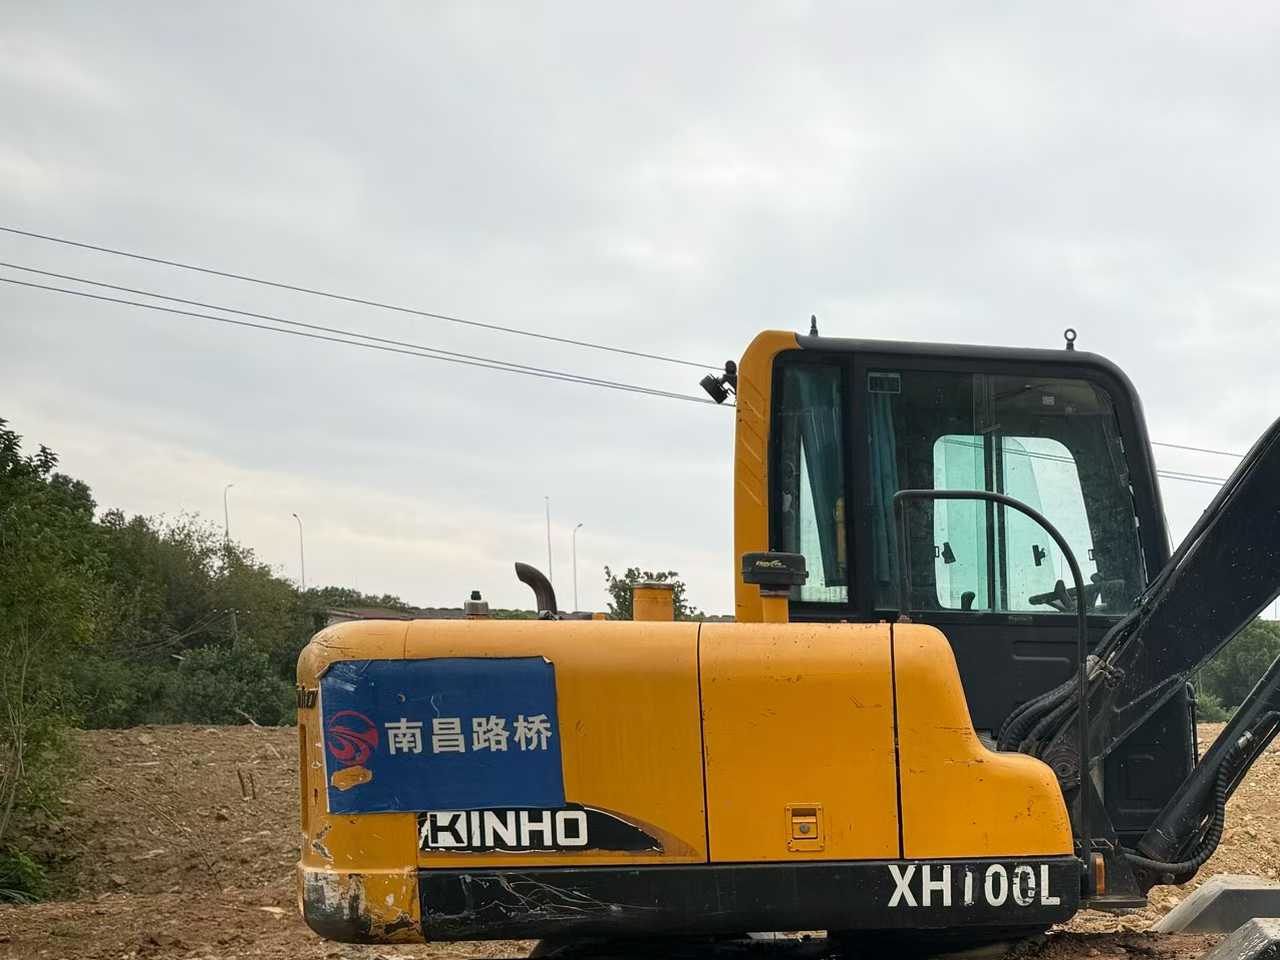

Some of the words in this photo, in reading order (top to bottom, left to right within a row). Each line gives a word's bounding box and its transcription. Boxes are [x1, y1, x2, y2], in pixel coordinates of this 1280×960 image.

[384, 713, 553, 755] 南昌路桥
[427, 810, 588, 847] KINHO
[887, 863, 1061, 907] XH100L
